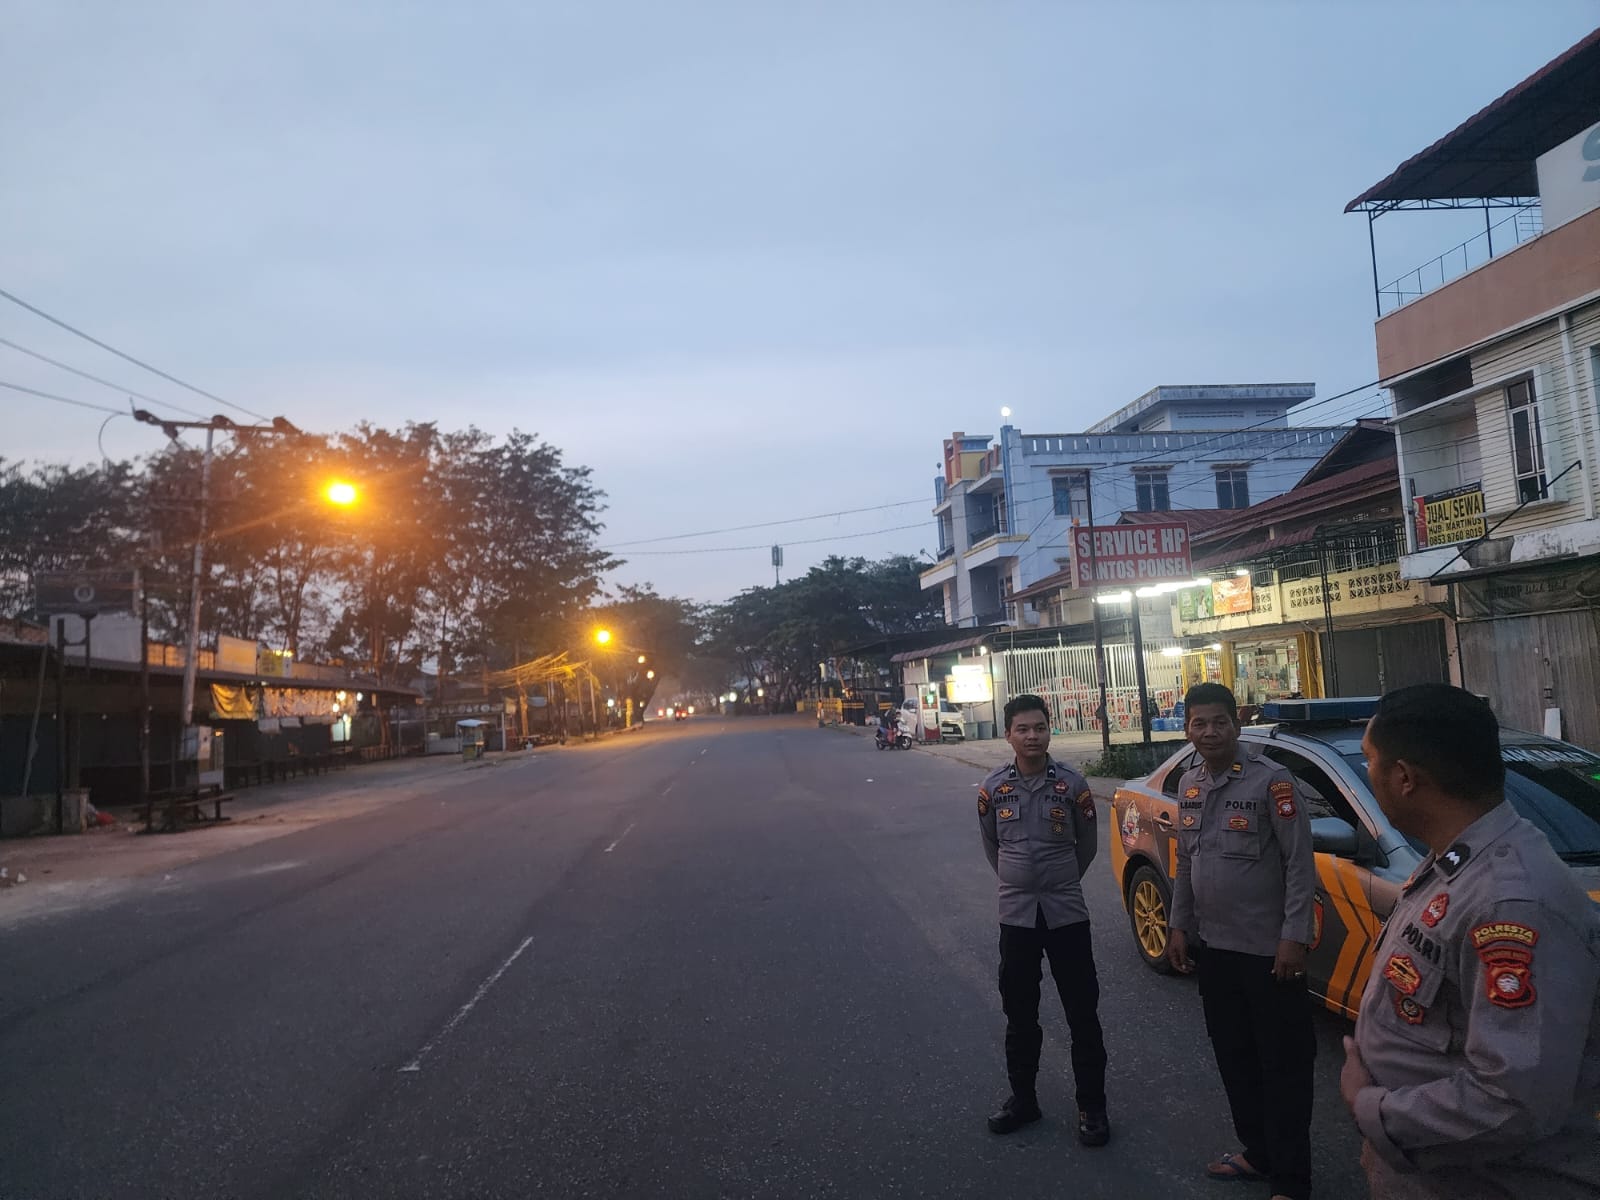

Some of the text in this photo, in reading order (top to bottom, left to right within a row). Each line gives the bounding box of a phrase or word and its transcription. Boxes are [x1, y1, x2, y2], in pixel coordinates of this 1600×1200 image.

[1426, 494, 1481, 525] JUAL/SEWA
[1446, 517, 1482, 531] MARTINUS
[1077, 528, 1186, 558] SERVICE HP
[1138, 557, 1189, 578] PONSEL
[1224, 800, 1257, 811] POLRI
[1401, 921, 1442, 965] POLRI
[1474, 924, 1534, 945] POLRESTA
